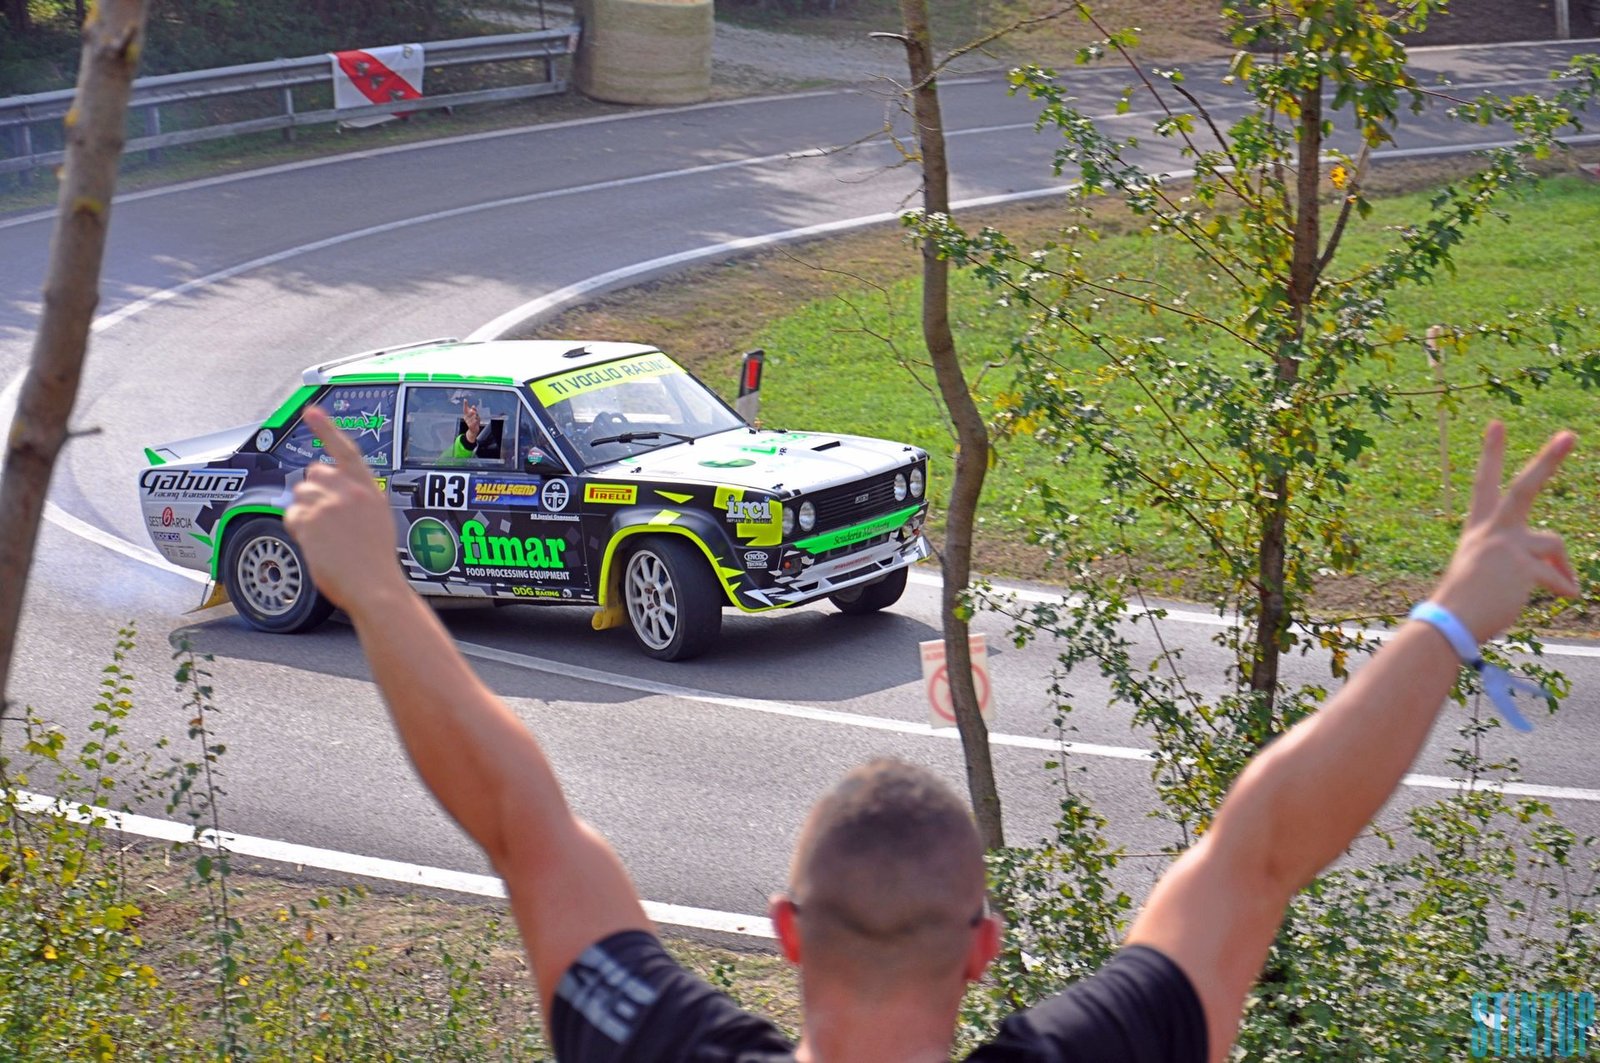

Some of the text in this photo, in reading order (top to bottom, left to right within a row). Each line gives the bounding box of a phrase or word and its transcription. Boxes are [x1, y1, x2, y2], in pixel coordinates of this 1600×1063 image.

[548, 383, 569, 395] TI
[569, 368, 623, 389] VOGLIO
[154, 491, 180, 500] racing
[427, 474, 466, 508] R3
[590, 487, 633, 501] PIRELLI
[475, 495, 500, 503] 2017
[726, 494, 772, 519] irci
[460, 520, 566, 569] fimar
[466, 567, 570, 580] FOOD PROCESSING EQUIPMENT
[512, 586, 560, 597] DDG RACING
